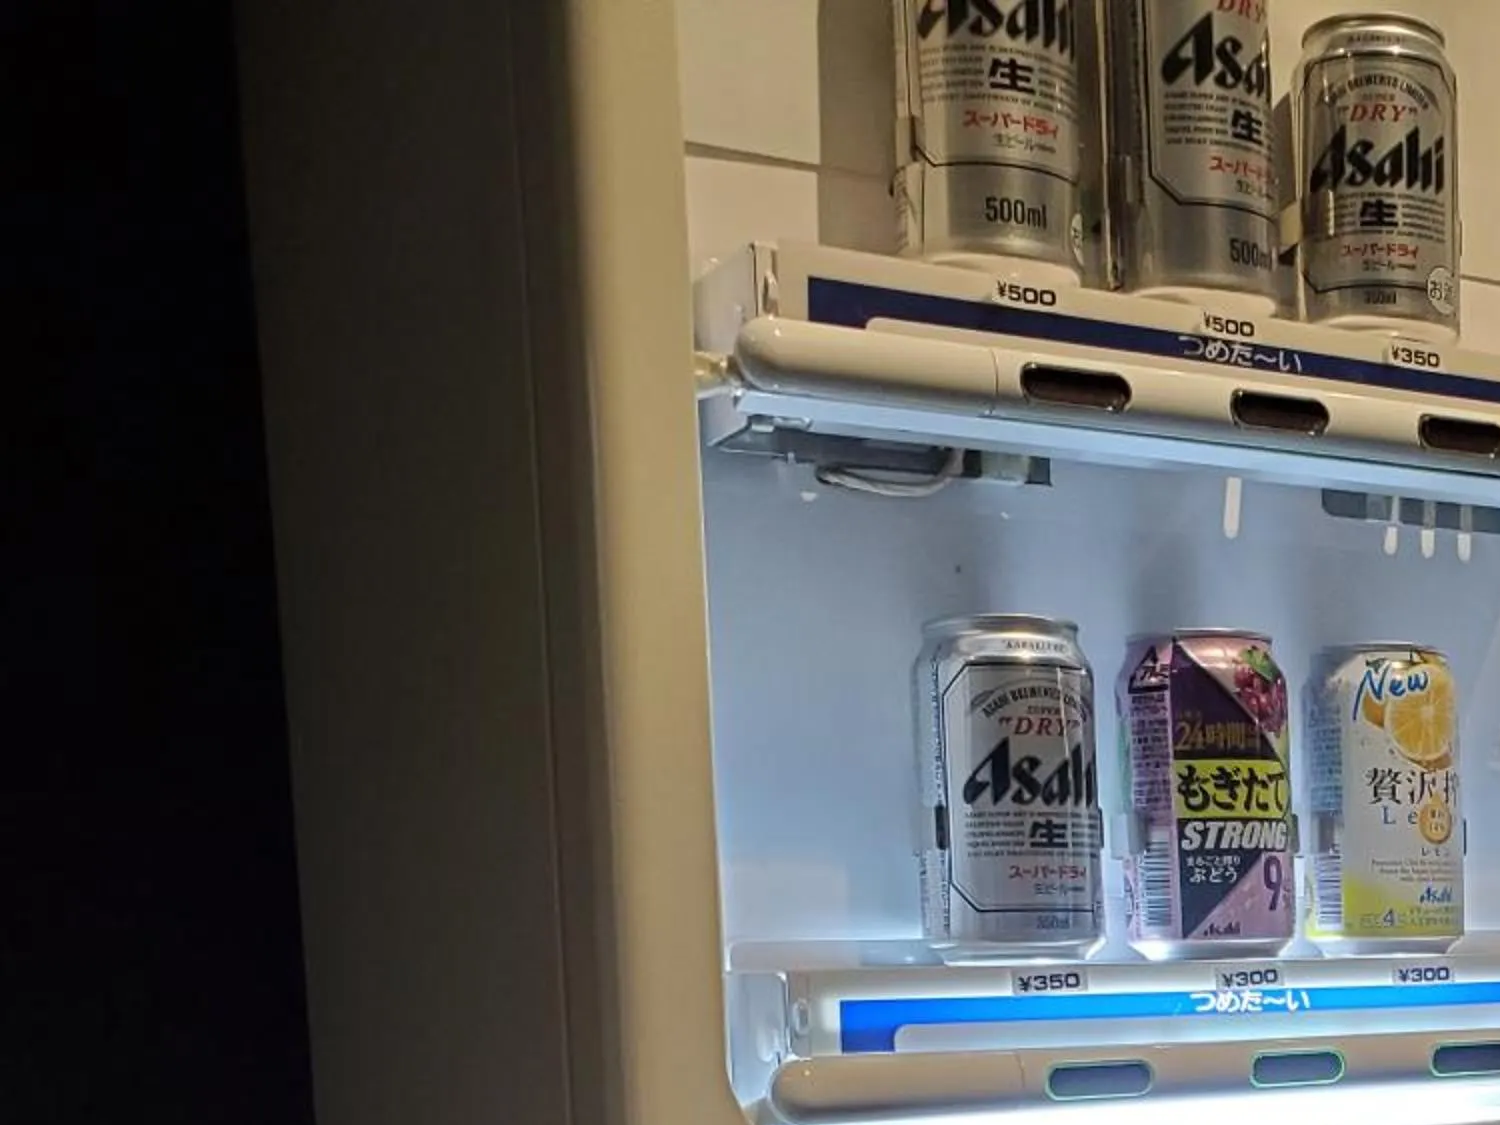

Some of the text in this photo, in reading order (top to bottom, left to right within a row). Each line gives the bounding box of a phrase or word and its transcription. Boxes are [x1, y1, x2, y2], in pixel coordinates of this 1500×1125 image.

[1161, 11, 1272, 104] Asa
[988, 57, 1037, 95] 生
[1231, 108, 1264, 146] 生
[1310, 124, 1445, 195] Asahi
[985, 197, 1048, 230] 500ml
[1359, 199, 1399, 227] 生
[996, 281, 1057, 307] ¥500
[1203, 311, 1256, 338] ¥500
[1391, 345, 1441, 368] ¥350
[1353, 663, 1430, 721] New
[1177, 764, 1286, 813] もぎたて
[1029, 820, 1069, 849] 生
[1181, 819, 1288, 852] STRONG
[1189, 866, 1238, 884] ぶどう
[1019, 973, 1081, 993] ¥350
[1222, 968, 1278, 988] ¥300
[1398, 966, 1450, 983] ¥300
